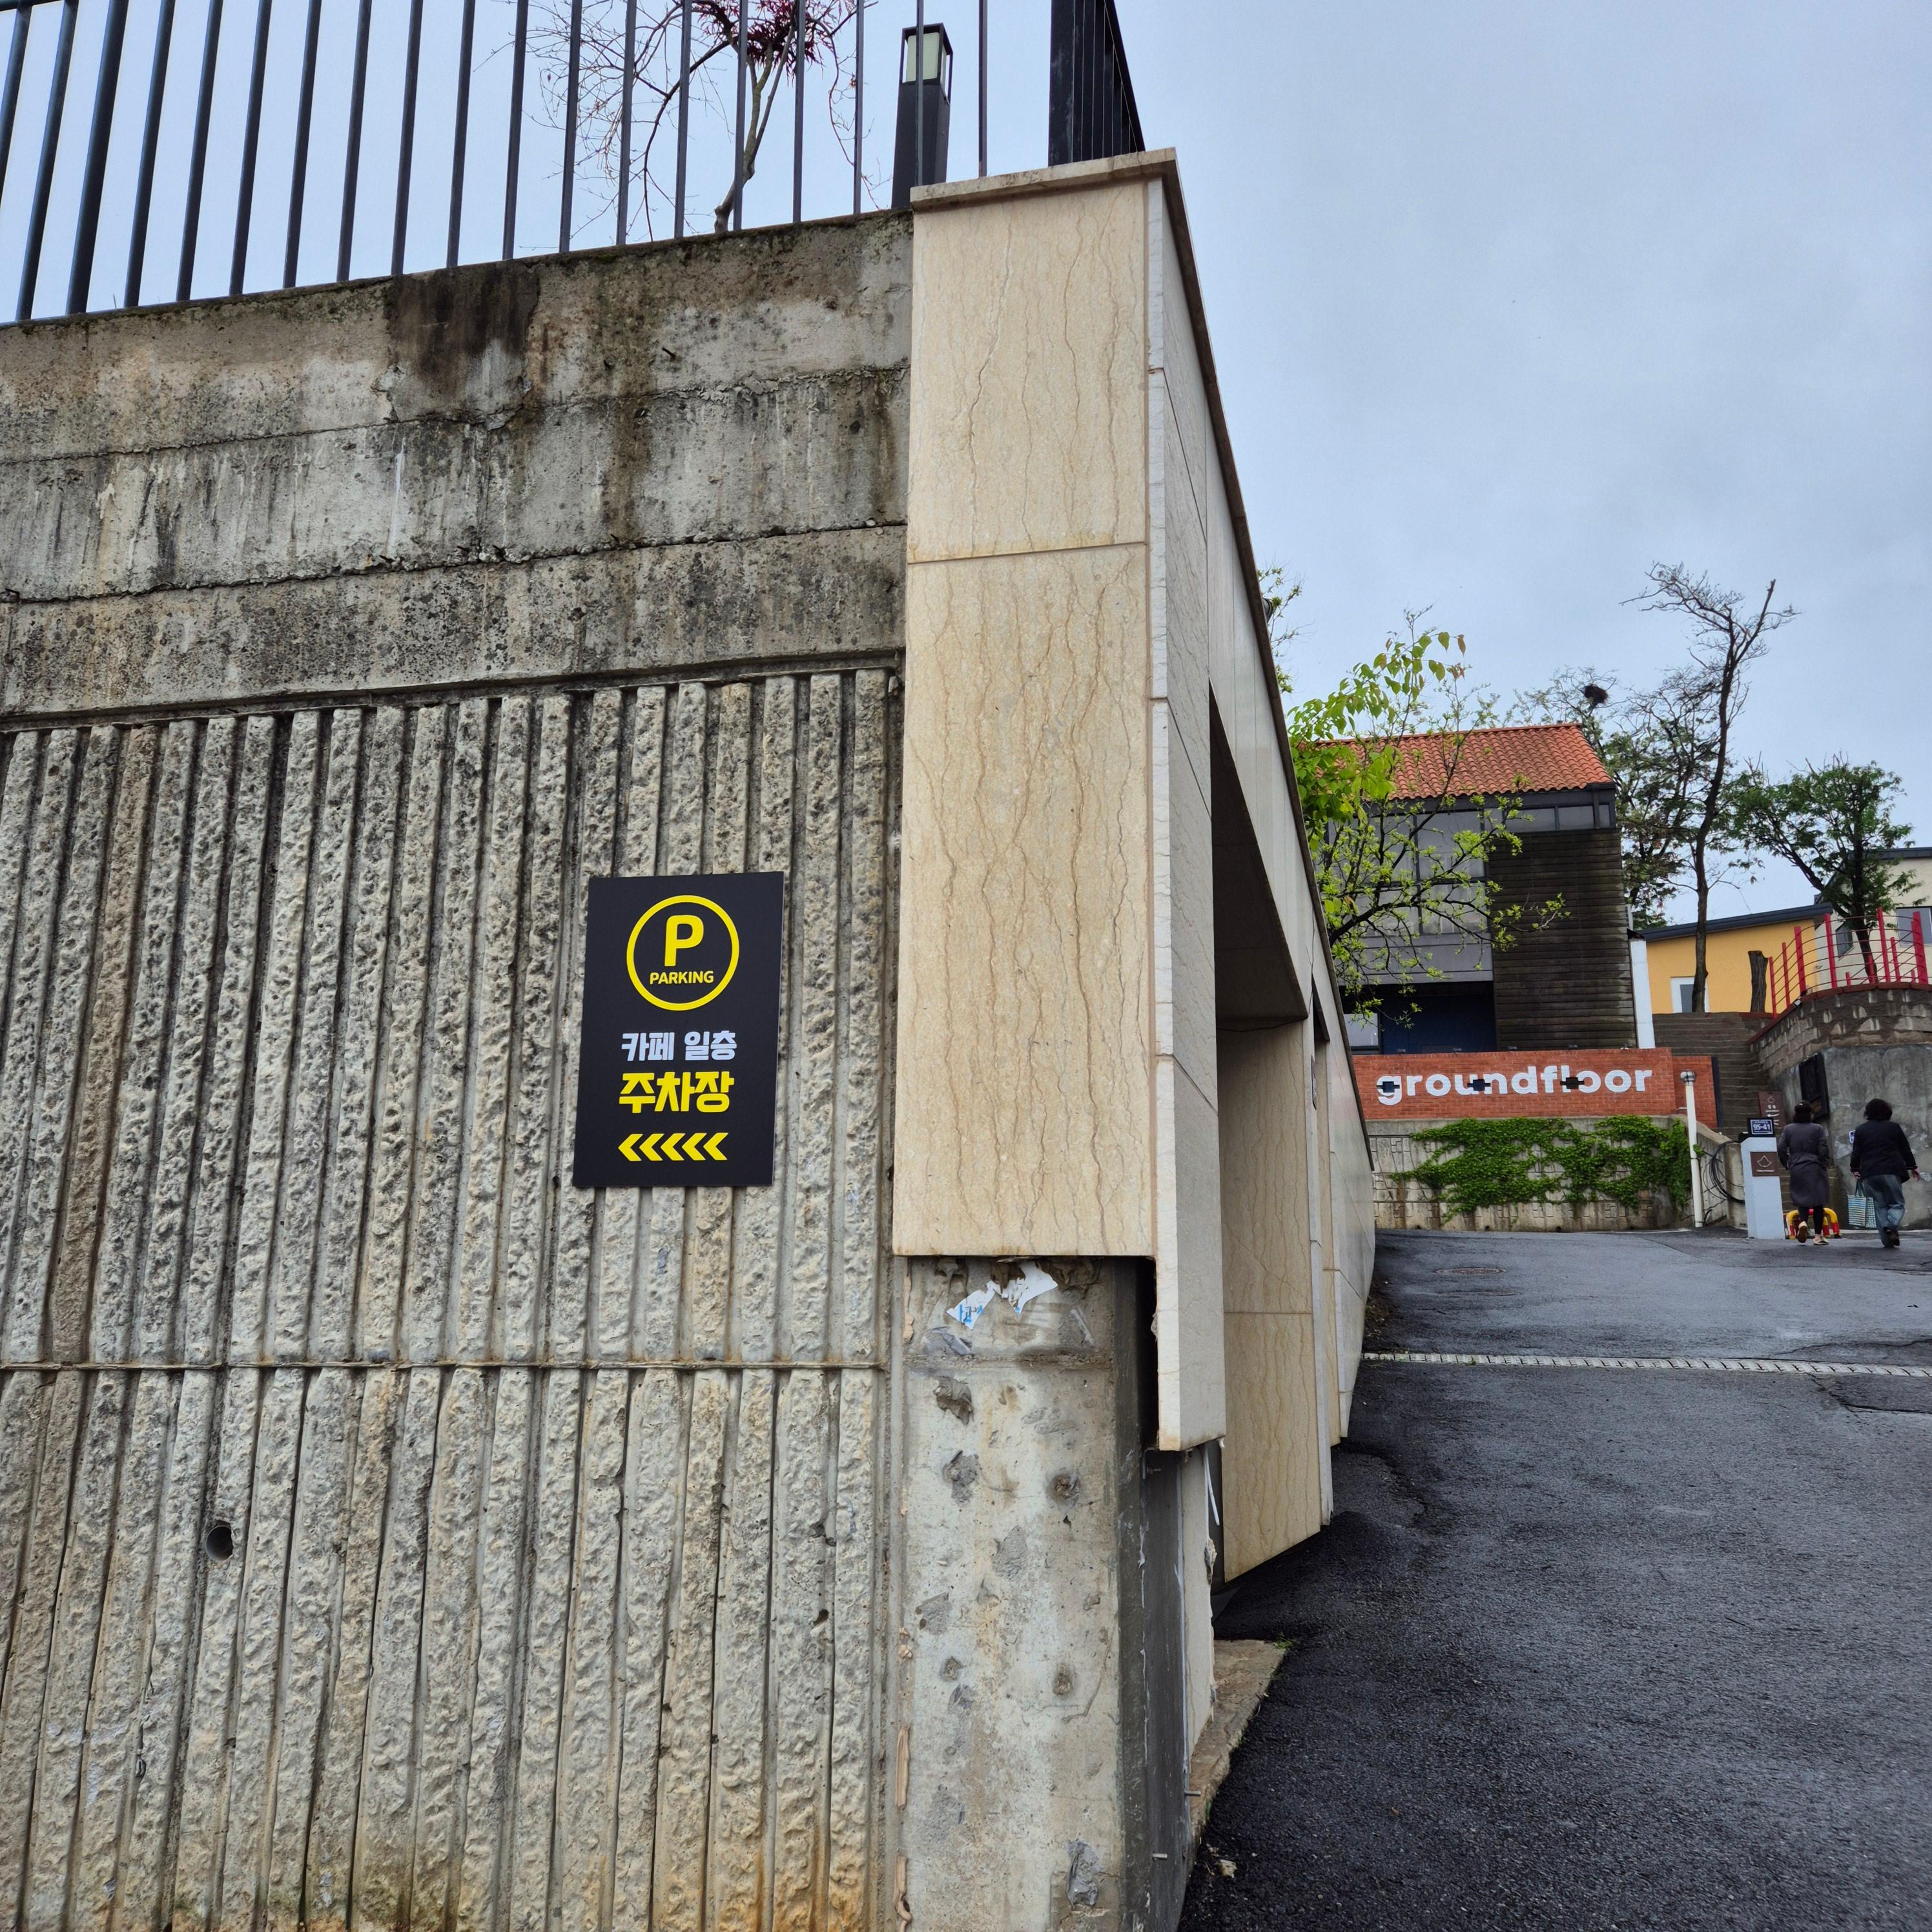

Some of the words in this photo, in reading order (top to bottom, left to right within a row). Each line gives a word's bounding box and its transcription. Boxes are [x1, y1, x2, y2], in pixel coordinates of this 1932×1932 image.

[664, 914, 704, 967] P
[650, 971, 714, 984] PARKING
[621, 1032, 675, 1061] 카페
[684, 1030, 737, 1061] 일층
[619, 1071, 735, 1114] 주차장
[1376, 1065, 1652, 1105] groundfloor
